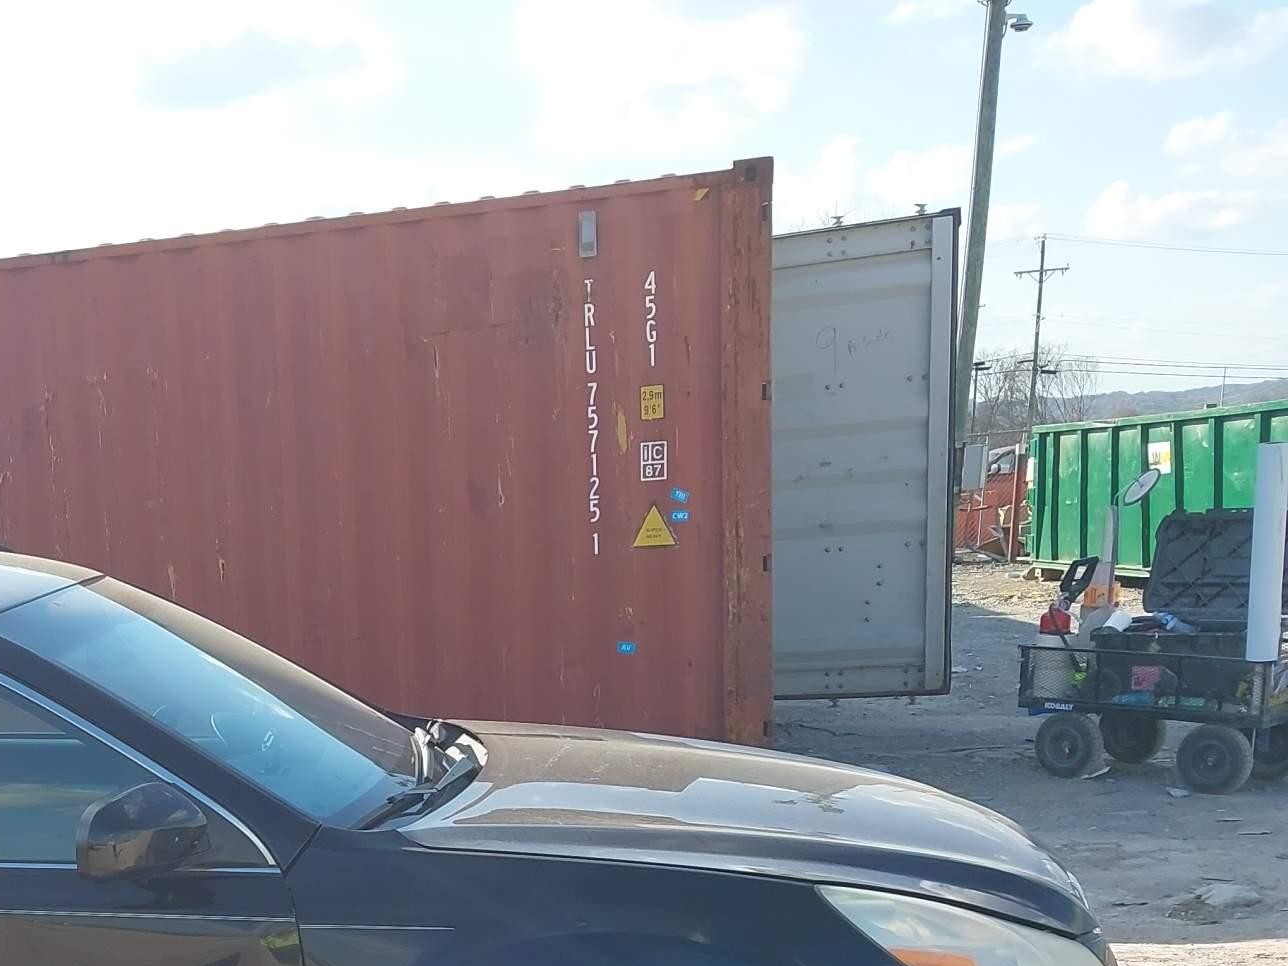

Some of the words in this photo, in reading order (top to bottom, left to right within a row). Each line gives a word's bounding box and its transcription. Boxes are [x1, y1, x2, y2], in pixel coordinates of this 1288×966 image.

[584, 279, 597, 374] TRLU
[644, 270, 657, 367] 45G1
[586, 382, 600, 523] 757125
[645, 464, 662, 477] 87
[592, 532, 599, 555] 1
